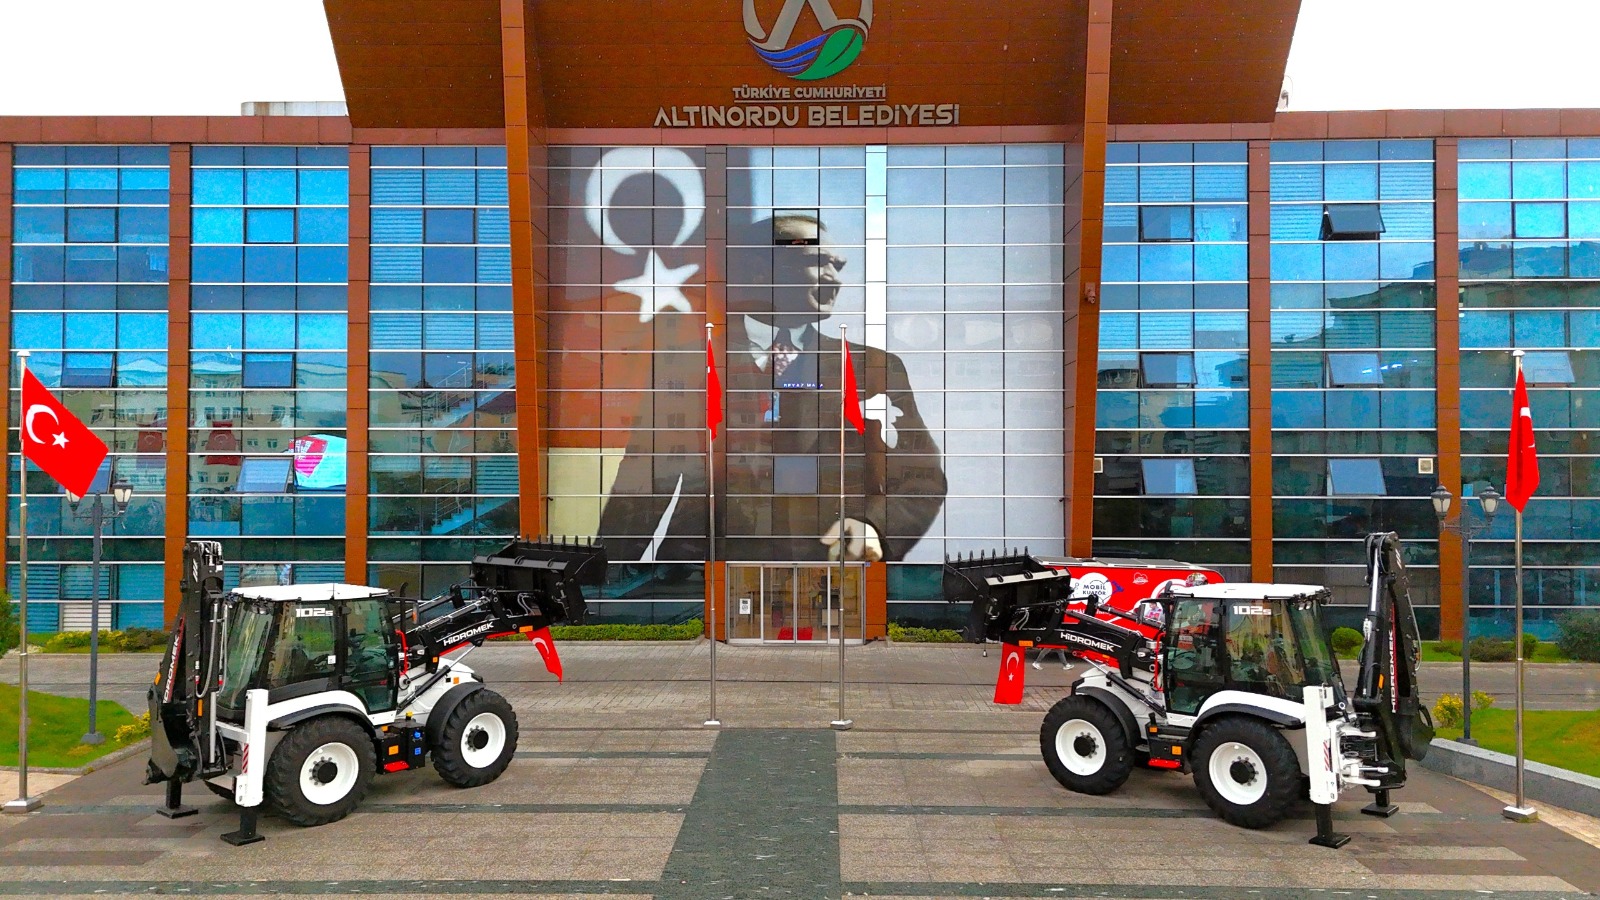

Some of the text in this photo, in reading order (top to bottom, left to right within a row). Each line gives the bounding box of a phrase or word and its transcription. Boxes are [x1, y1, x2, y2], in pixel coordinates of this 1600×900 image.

[732, 83, 886, 99] TÜRKİYE CUMHURİYETİ
[653, 103, 960, 127] ALTINORDU BELEDİYESİ
